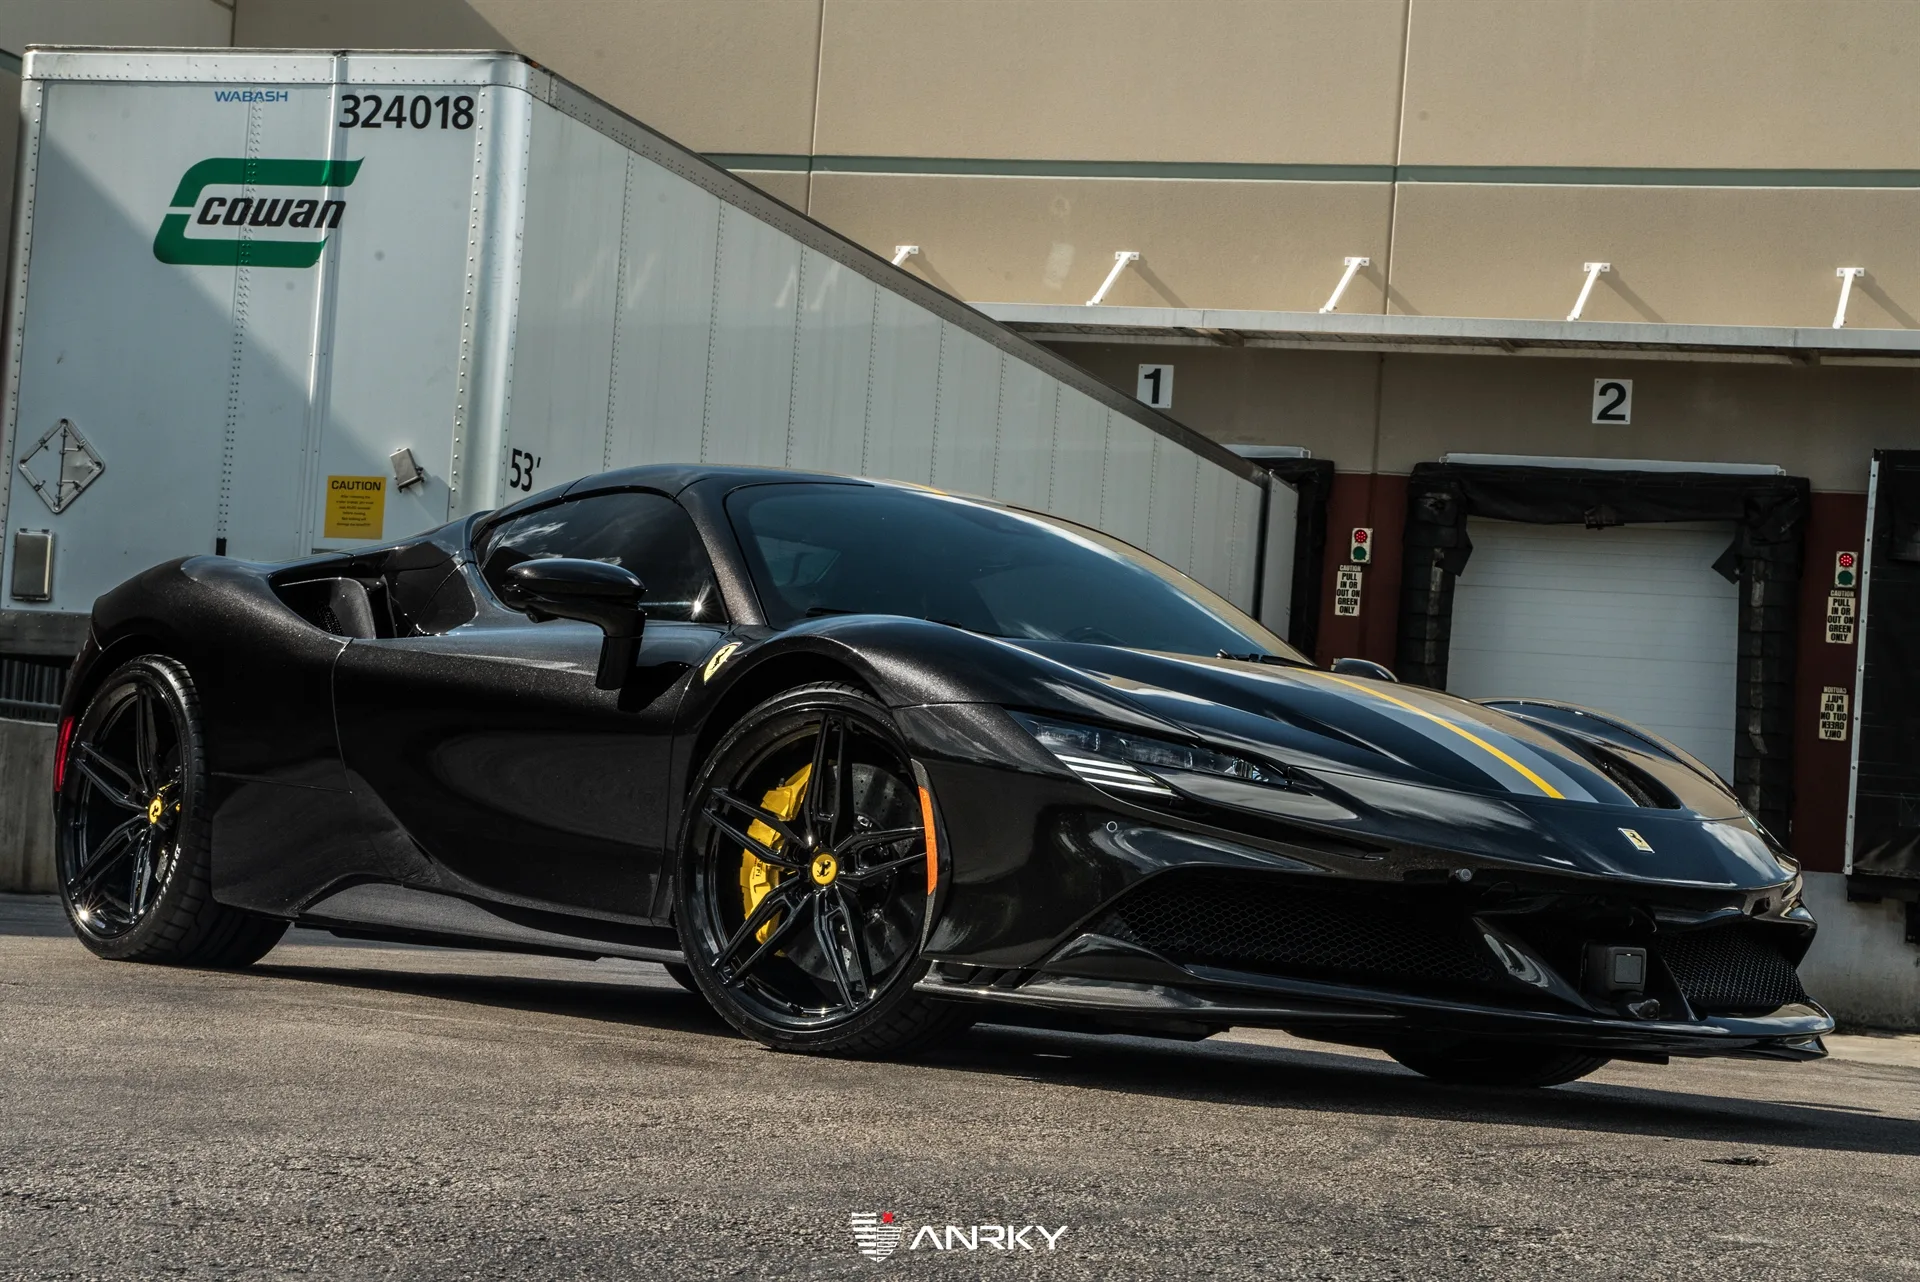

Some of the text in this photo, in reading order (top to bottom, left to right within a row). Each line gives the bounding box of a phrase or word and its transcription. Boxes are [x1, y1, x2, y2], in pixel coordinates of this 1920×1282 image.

[214, 91, 289, 102] WABASH
[338, 94, 475, 130] 324018
[1144, 368, 1162, 404] 1
[1597, 382, 1627, 421] 2
[331, 480, 382, 491] CAUTION
[1342, 572, 1357, 580] PULL
[1340, 581, 1358, 589] IN OR
[1336, 589, 1361, 598] OUT ON
[1337, 597, 1358, 606] GREEN
[1832, 598, 1851, 607] PULL
[1339, 606, 1356, 614] ONLY
[1831, 606, 1852, 616] IN OR
[1827, 615, 1854, 625] OUT ON
[1828, 624, 1852, 634] GREEN
[1830, 633, 1849, 642] ONLY
